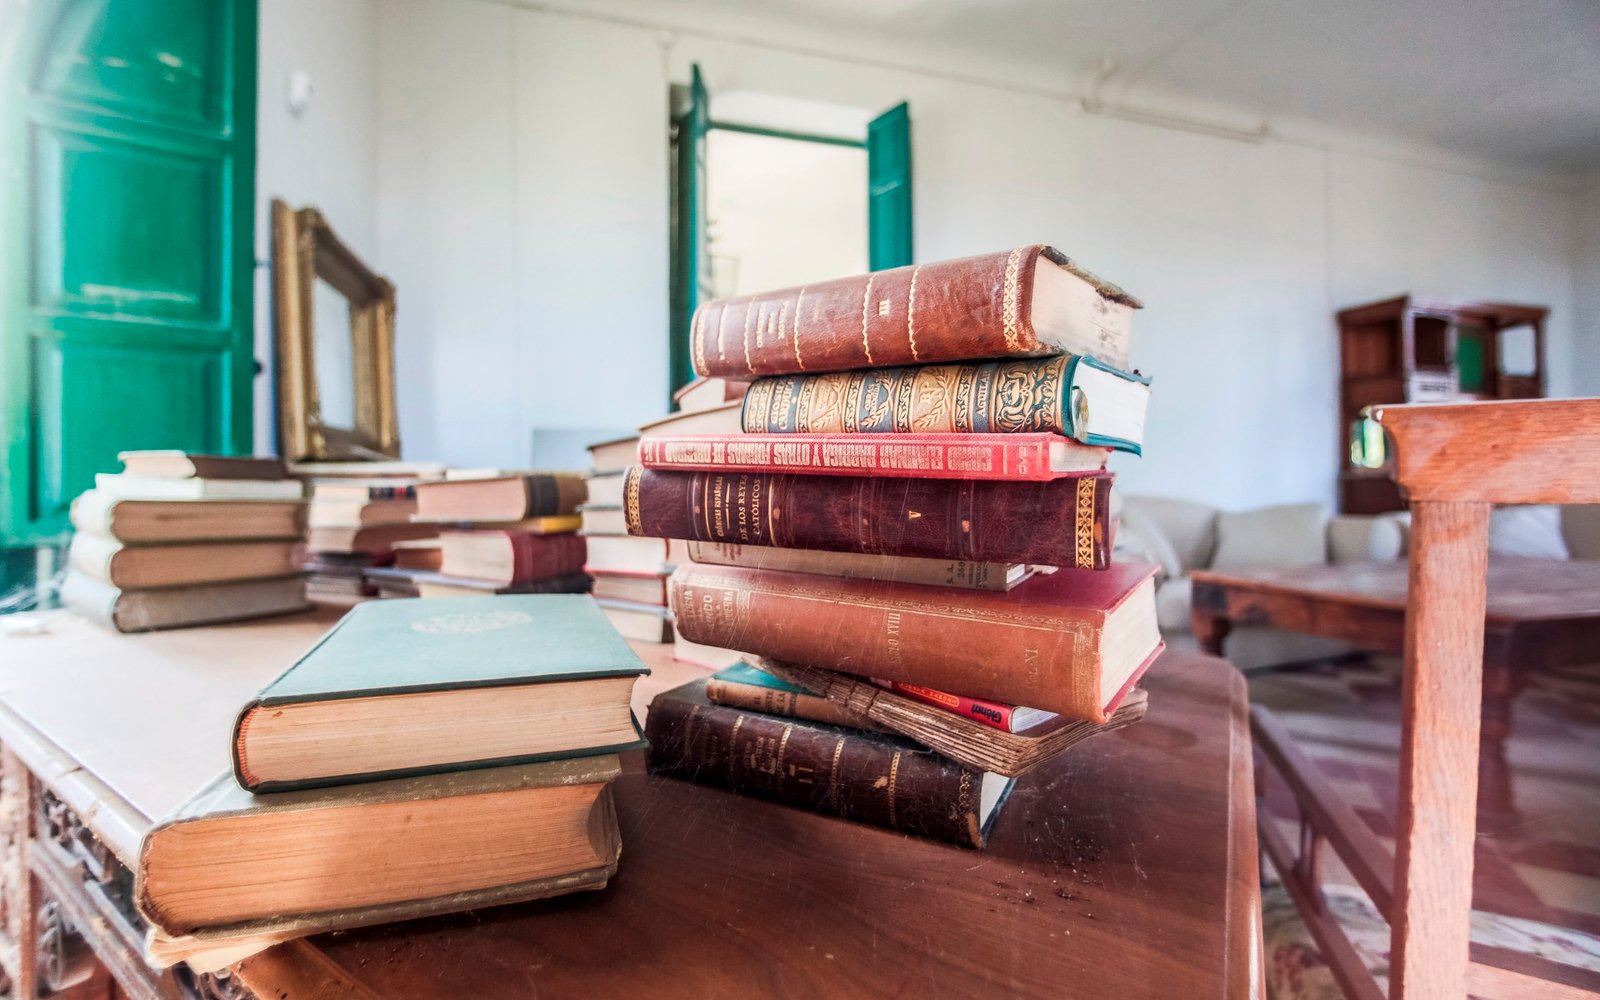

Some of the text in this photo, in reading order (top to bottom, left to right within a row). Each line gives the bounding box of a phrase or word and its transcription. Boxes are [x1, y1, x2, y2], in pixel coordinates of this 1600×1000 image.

[712, 442, 726, 464] DE
[726, 442, 771, 465] FORMAS
[773, 443, 811, 466] OTRAS
[811, 443, 822, 466] Y
[823, 443, 877, 468] BARRIGA
[879, 444, 944, 470] ELIMINAR
[947, 445, 992, 471] COMO
[738, 506, 746, 526] LOS
[751, 479, 761, 535] CATÓLICOS
